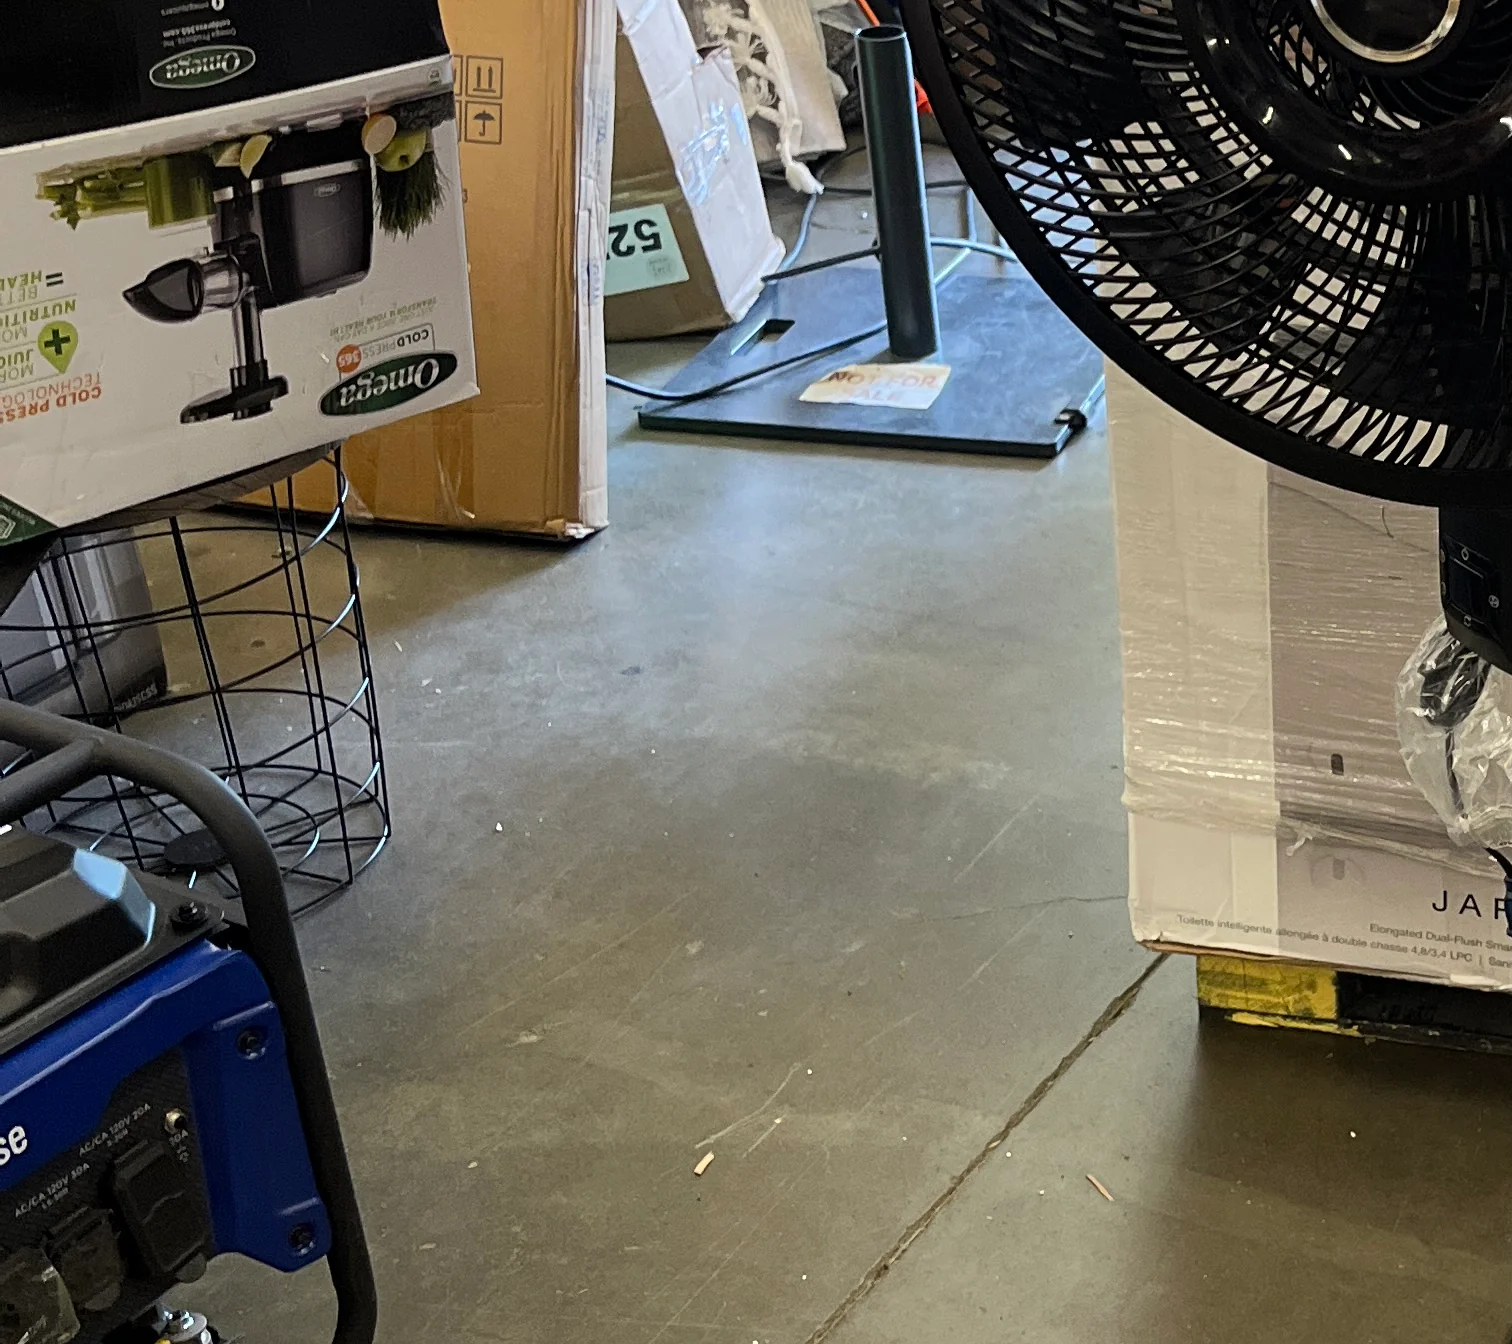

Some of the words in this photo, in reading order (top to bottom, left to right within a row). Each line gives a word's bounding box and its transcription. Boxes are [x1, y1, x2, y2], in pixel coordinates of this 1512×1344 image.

[166, 51, 241, 79] Omega
[56, 385, 102, 407] COLD
[340, 358, 440, 407] Omega
[1176, 913, 1215, 927] Toilette
[1217, 920, 1273, 936] intelligente
[1275, 927, 1320, 943] allongée
[1331, 934, 1368, 949] double
[1369, 940, 1409, 954] chasse
[1449, 950, 1474, 963] LPC
[1369, 923, 1423, 941] Elongated
[1425, 931, 1483, 948] Dual-Flush
[15, 1191, 46, 1218] AC/CA
